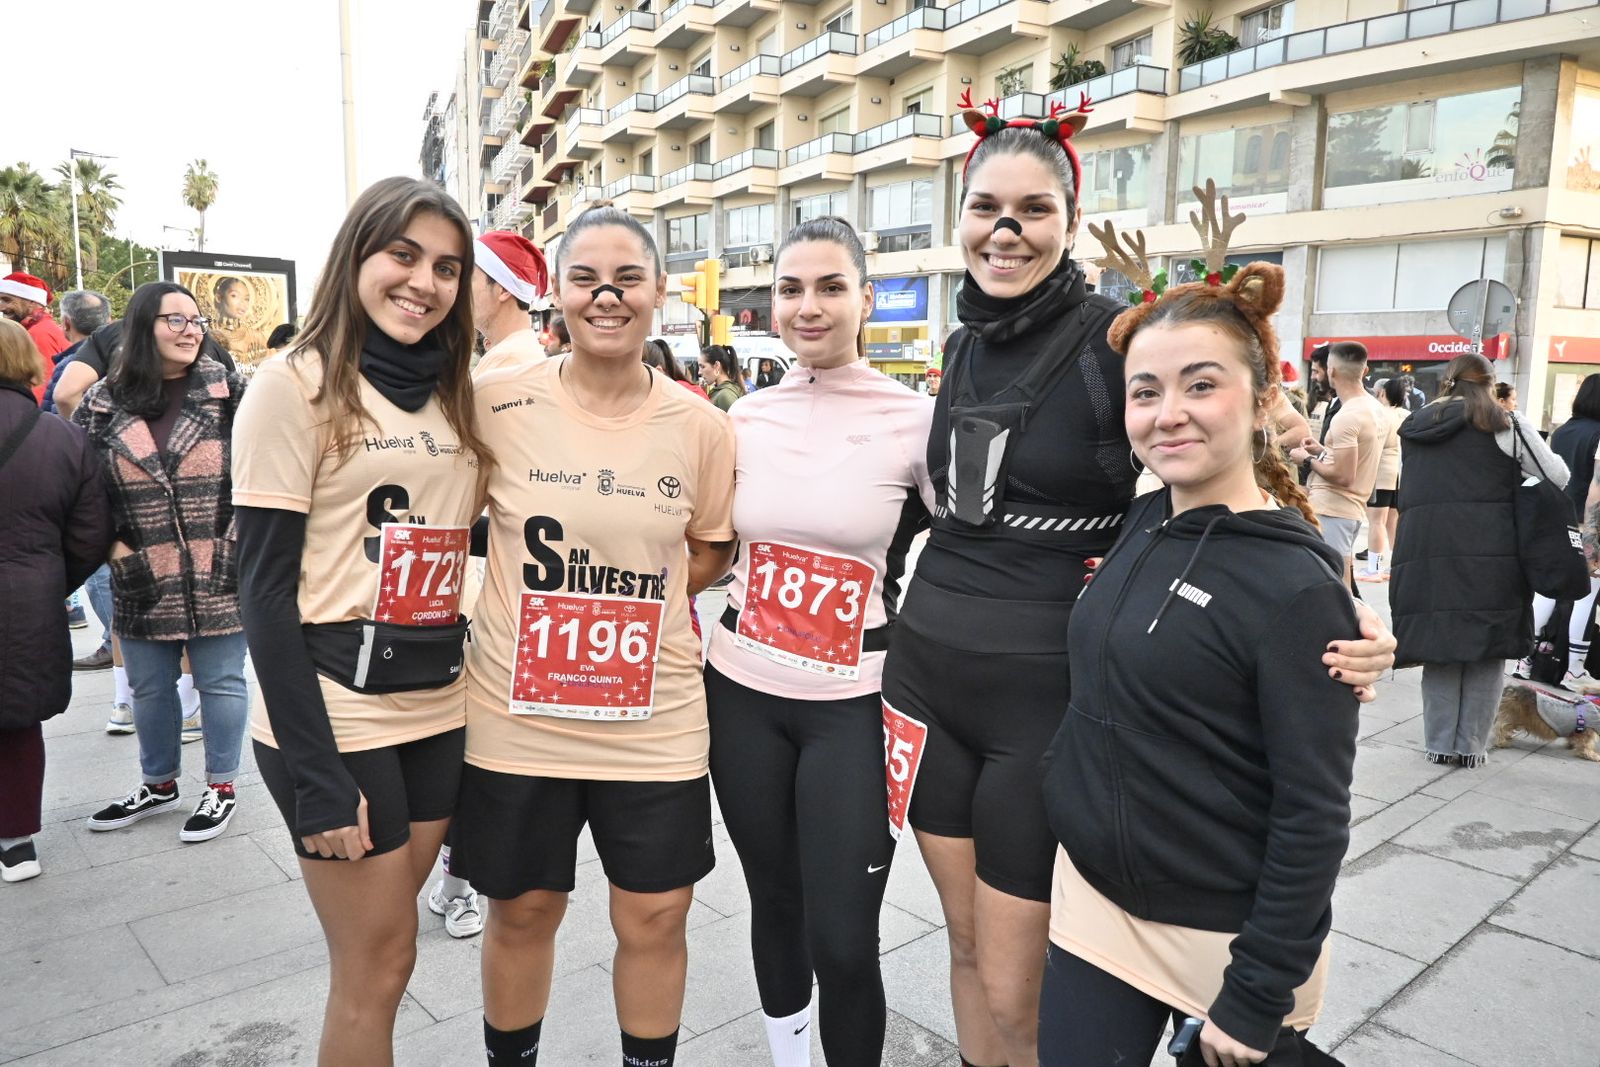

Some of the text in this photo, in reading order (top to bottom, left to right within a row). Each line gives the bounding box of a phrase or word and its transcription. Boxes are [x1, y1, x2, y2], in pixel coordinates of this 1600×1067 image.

[1428, 341, 1484, 353] Occidet
[491, 398, 522, 413] luanvi
[365, 436, 414, 452] Huelva
[529, 469, 585, 484] Huelva
[616, 488, 645, 498] HUELVA
[654, 503, 682, 516] HUELVA
[757, 544, 772, 553] 5K
[782, 551, 807, 563] Huelva
[391, 549, 465, 597] 1723
[756, 561, 861, 622] 1873
[529, 597, 545, 607] 5K
[557, 602, 586, 611] Huelva
[529, 615, 649, 664] 1196
[579, 664, 596, 672] EVA
[548, 673, 587, 683] FRANCO
[589, 674, 623, 685] QUINTA
